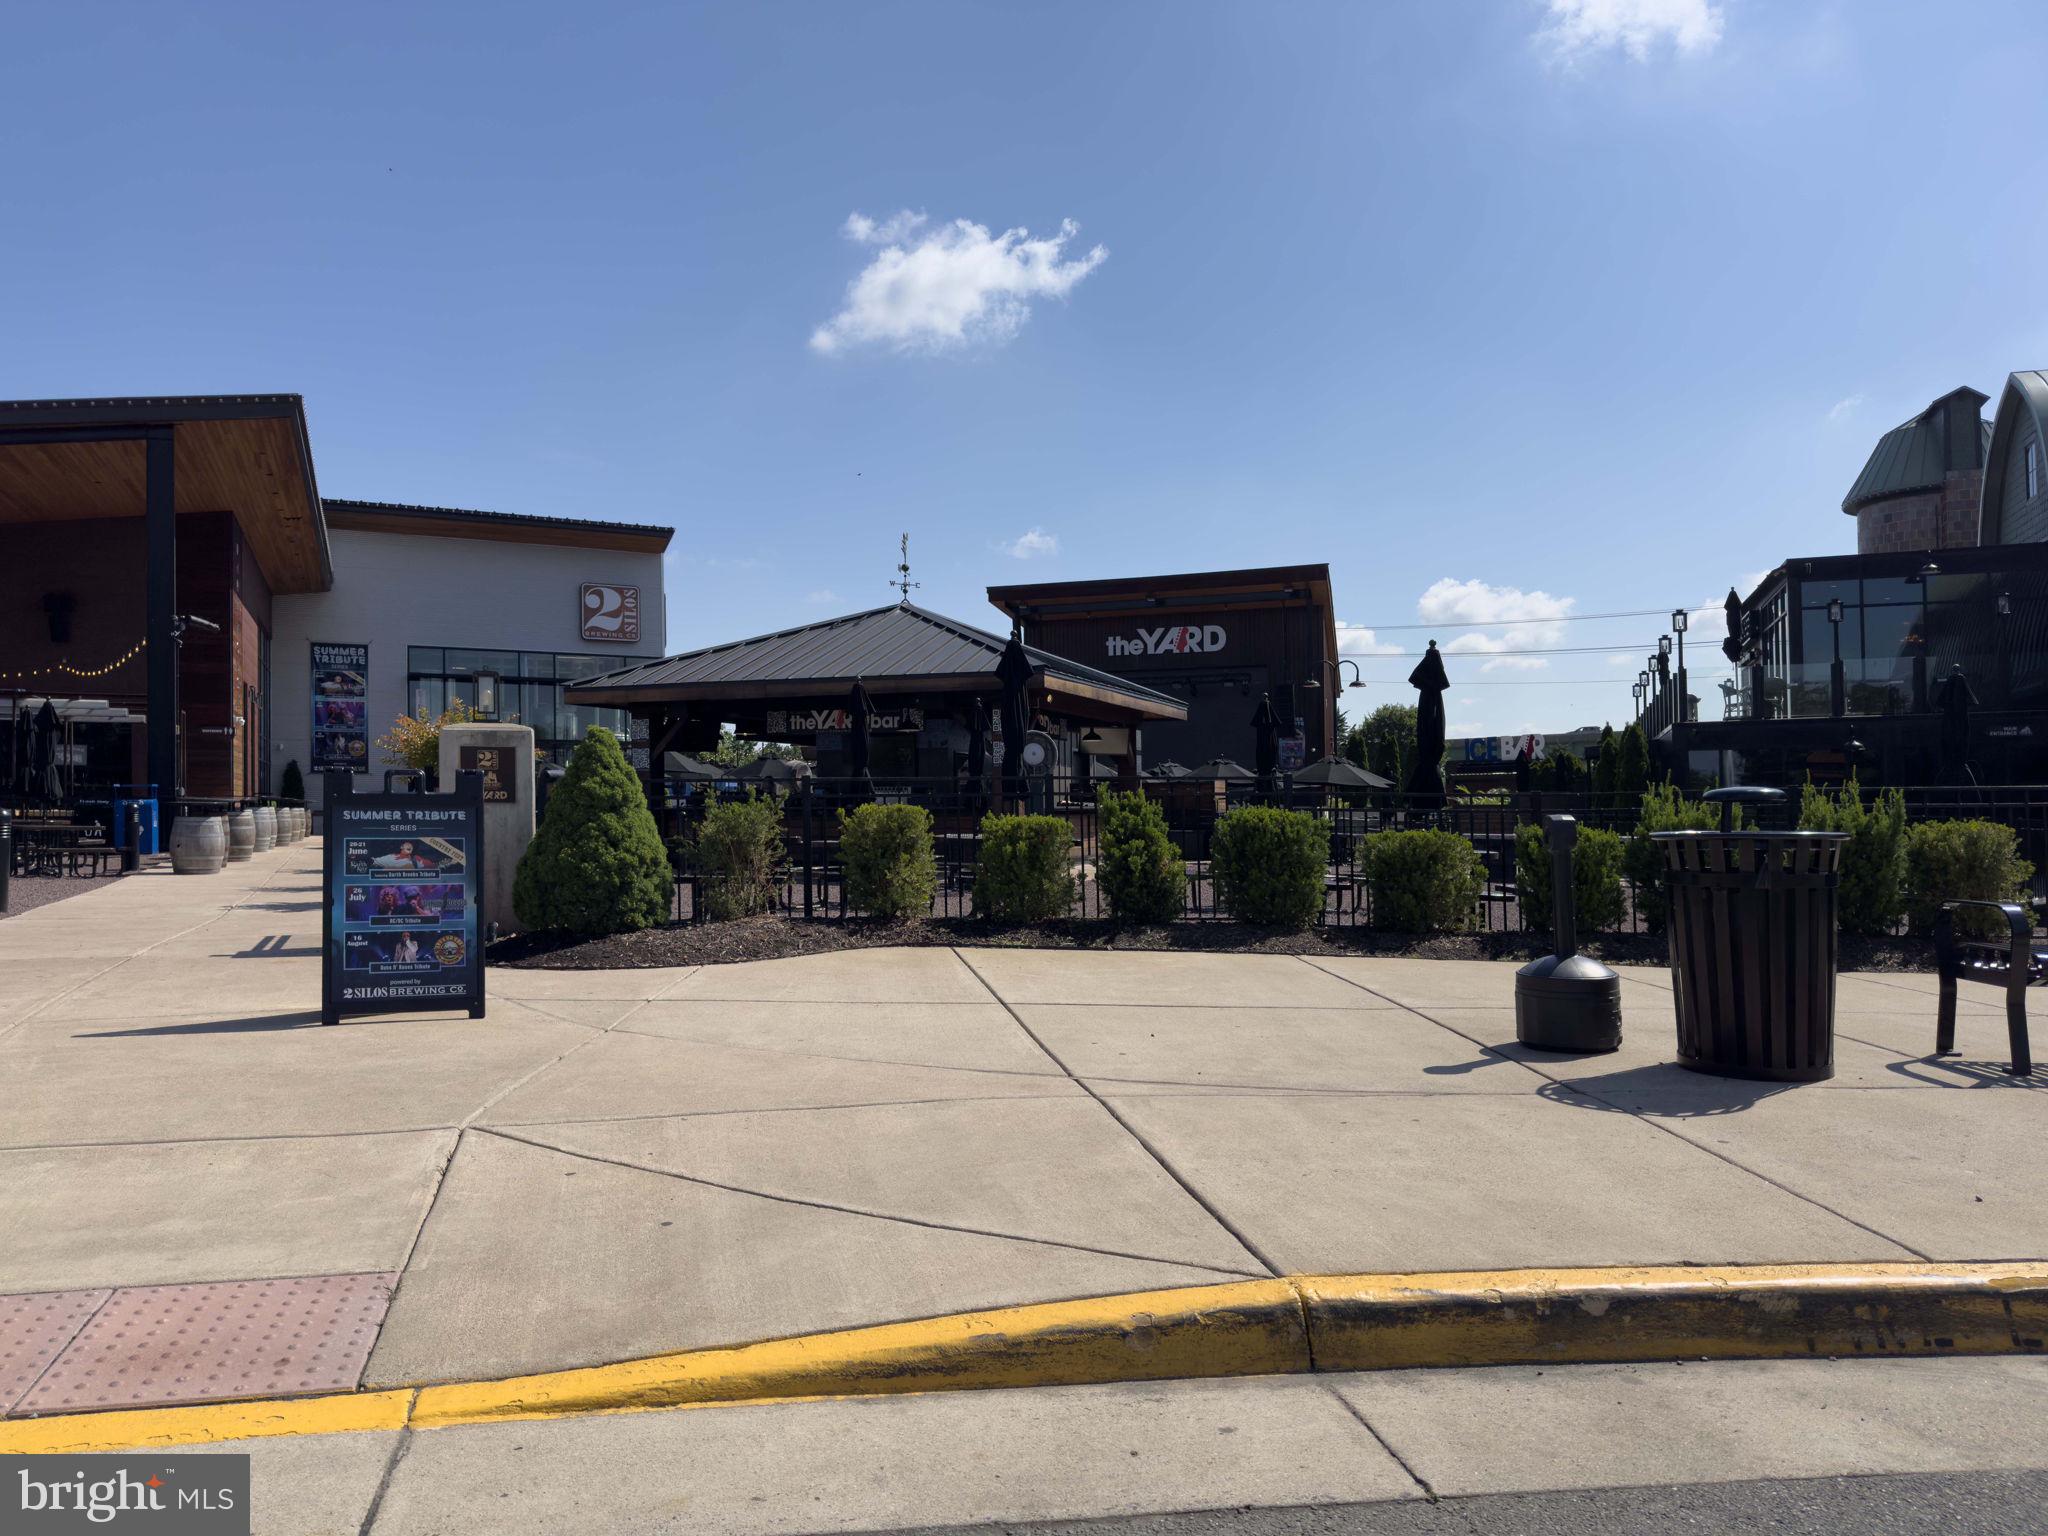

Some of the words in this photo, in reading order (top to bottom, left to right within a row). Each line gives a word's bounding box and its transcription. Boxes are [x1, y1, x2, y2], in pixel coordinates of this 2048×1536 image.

[585, 587, 623, 632] 2
[624, 589, 636, 633] SILOS
[1106, 625, 1227, 656] theYARD
[313, 646, 366, 656] SUMMER
[314, 655, 366, 665] TRIBUTE
[479, 751, 492, 767] 2
[343, 810, 402, 820] SUMMER
[406, 810, 467, 820] TRIBUTE
[348, 847, 368, 855] June
[348, 893, 367, 902] July
[343, 988, 353, 998] 2
[354, 987, 388, 998] SILOS
[389, 987, 445, 995] BREWING
